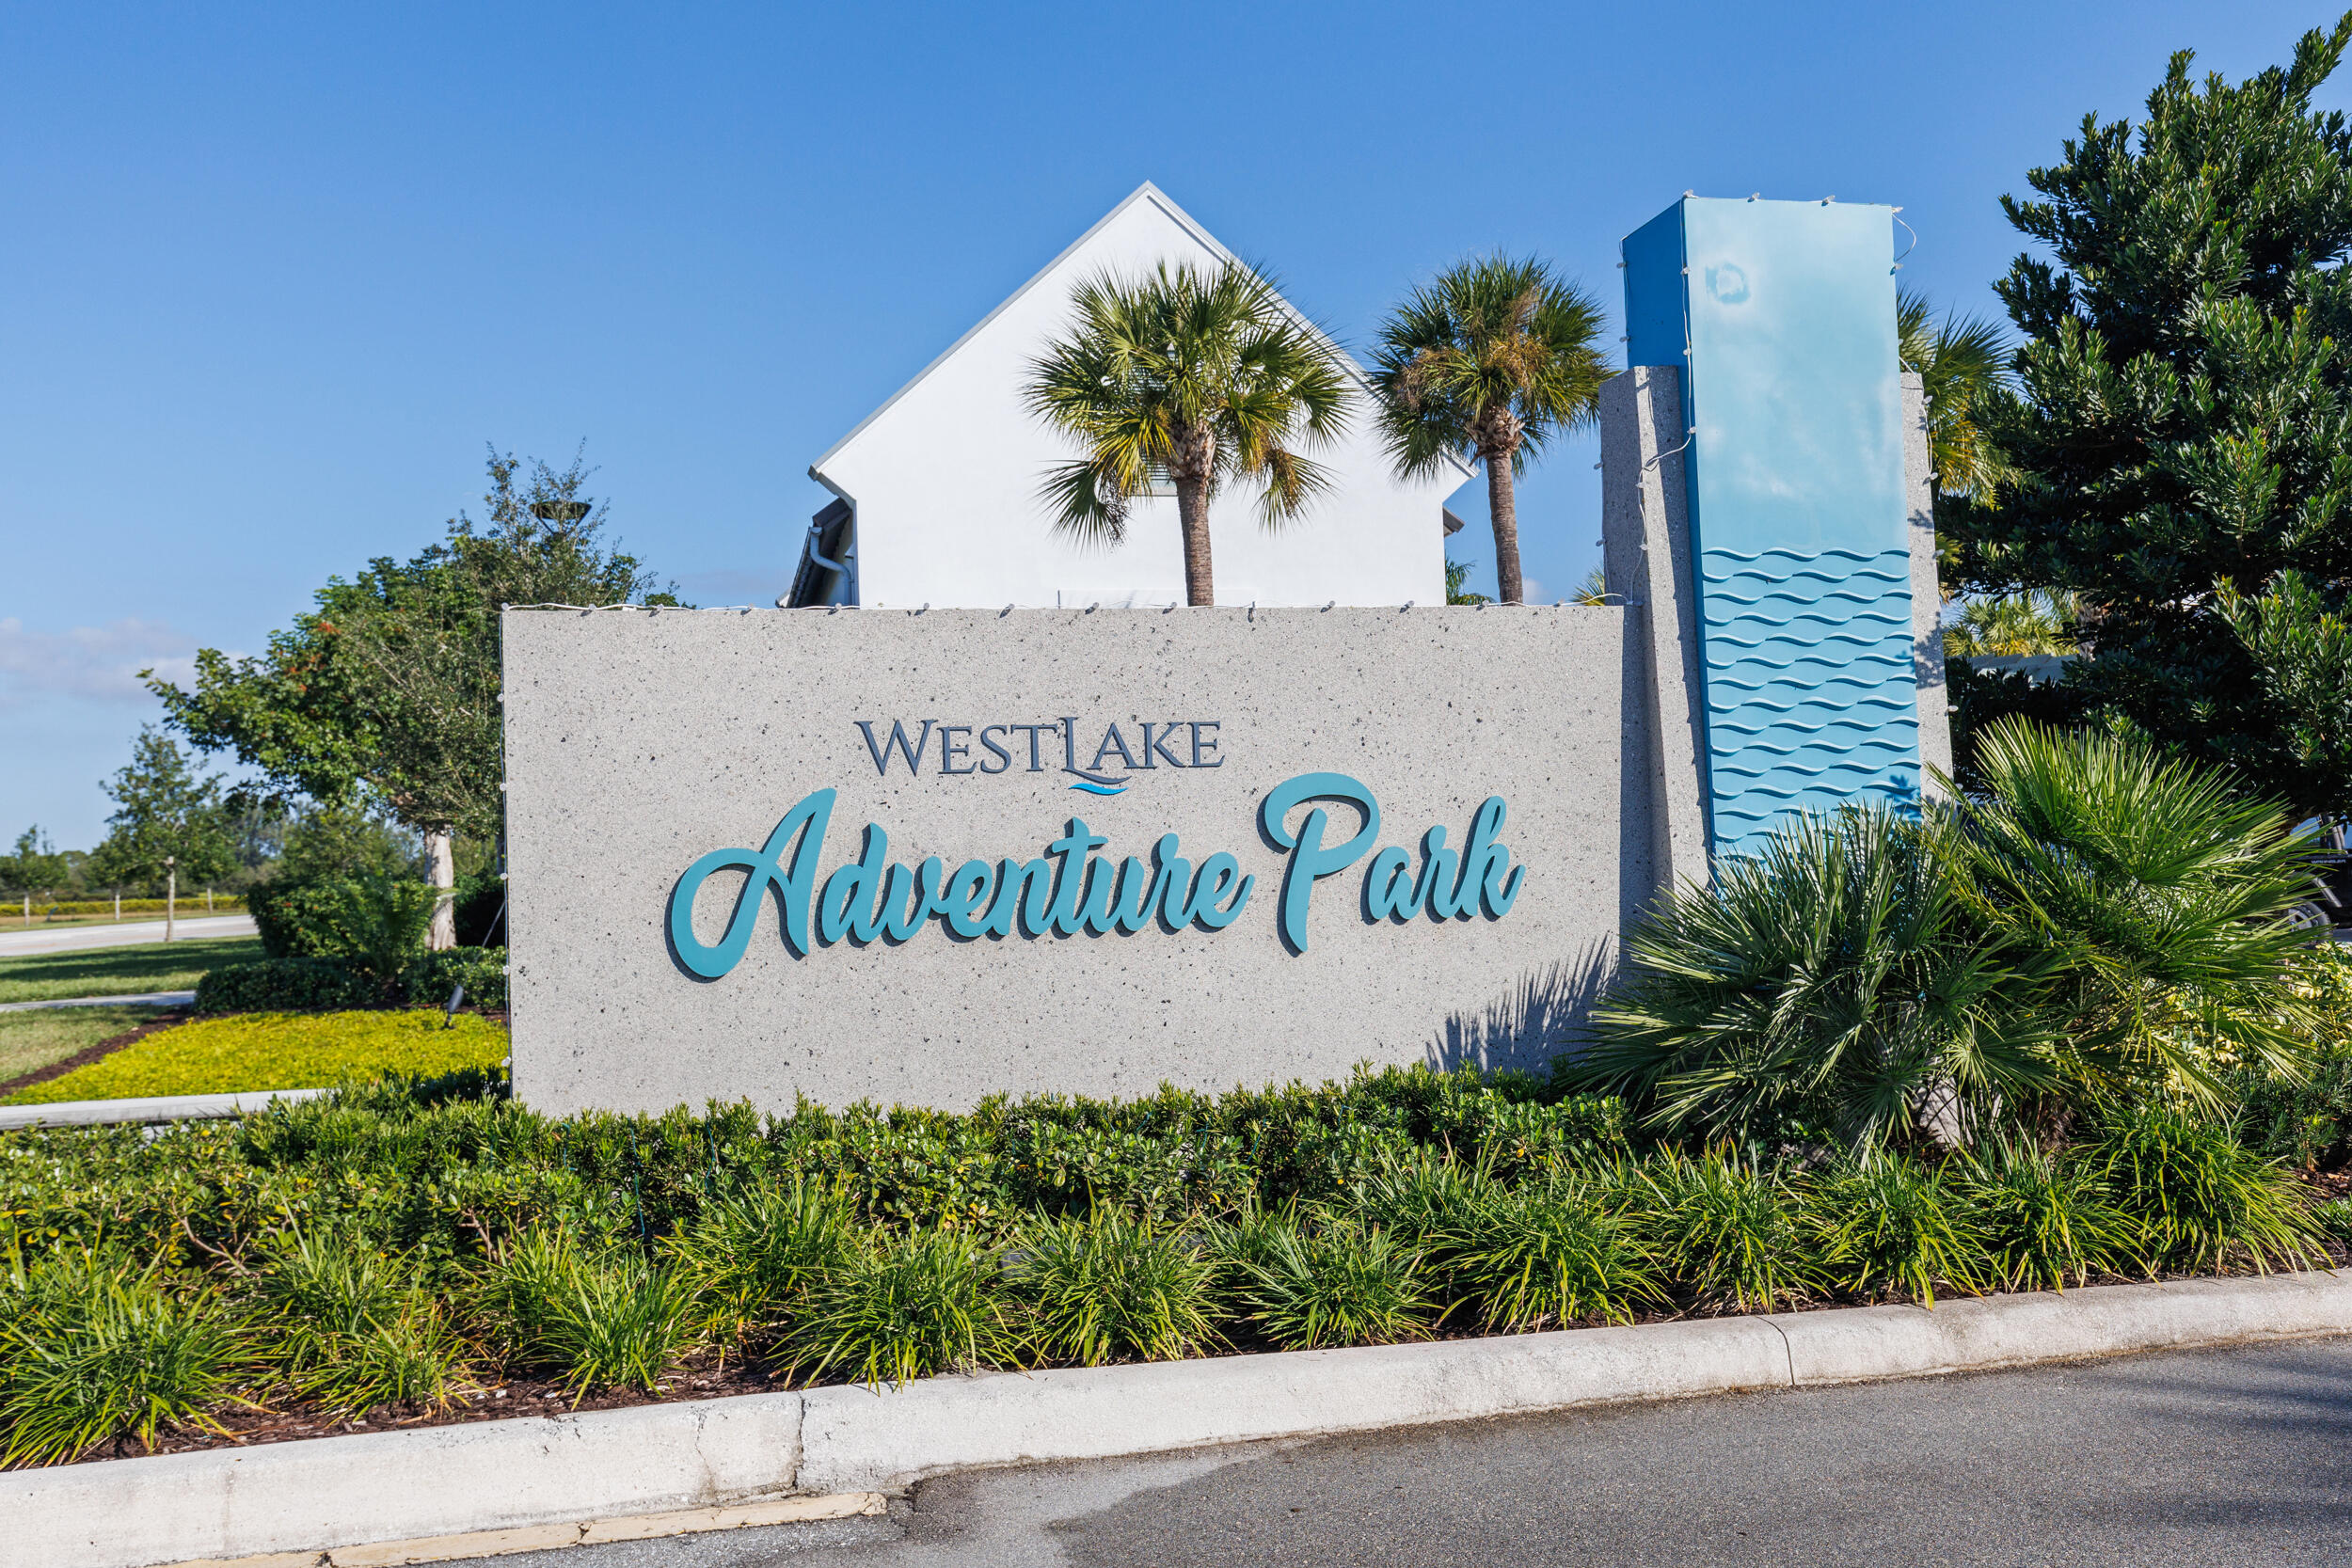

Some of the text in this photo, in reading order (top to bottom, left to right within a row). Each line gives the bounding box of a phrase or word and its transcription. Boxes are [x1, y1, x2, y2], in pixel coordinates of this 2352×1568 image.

[852, 717, 1225, 784] WESTLAKE
[668, 771, 1526, 979] Adventure Park
